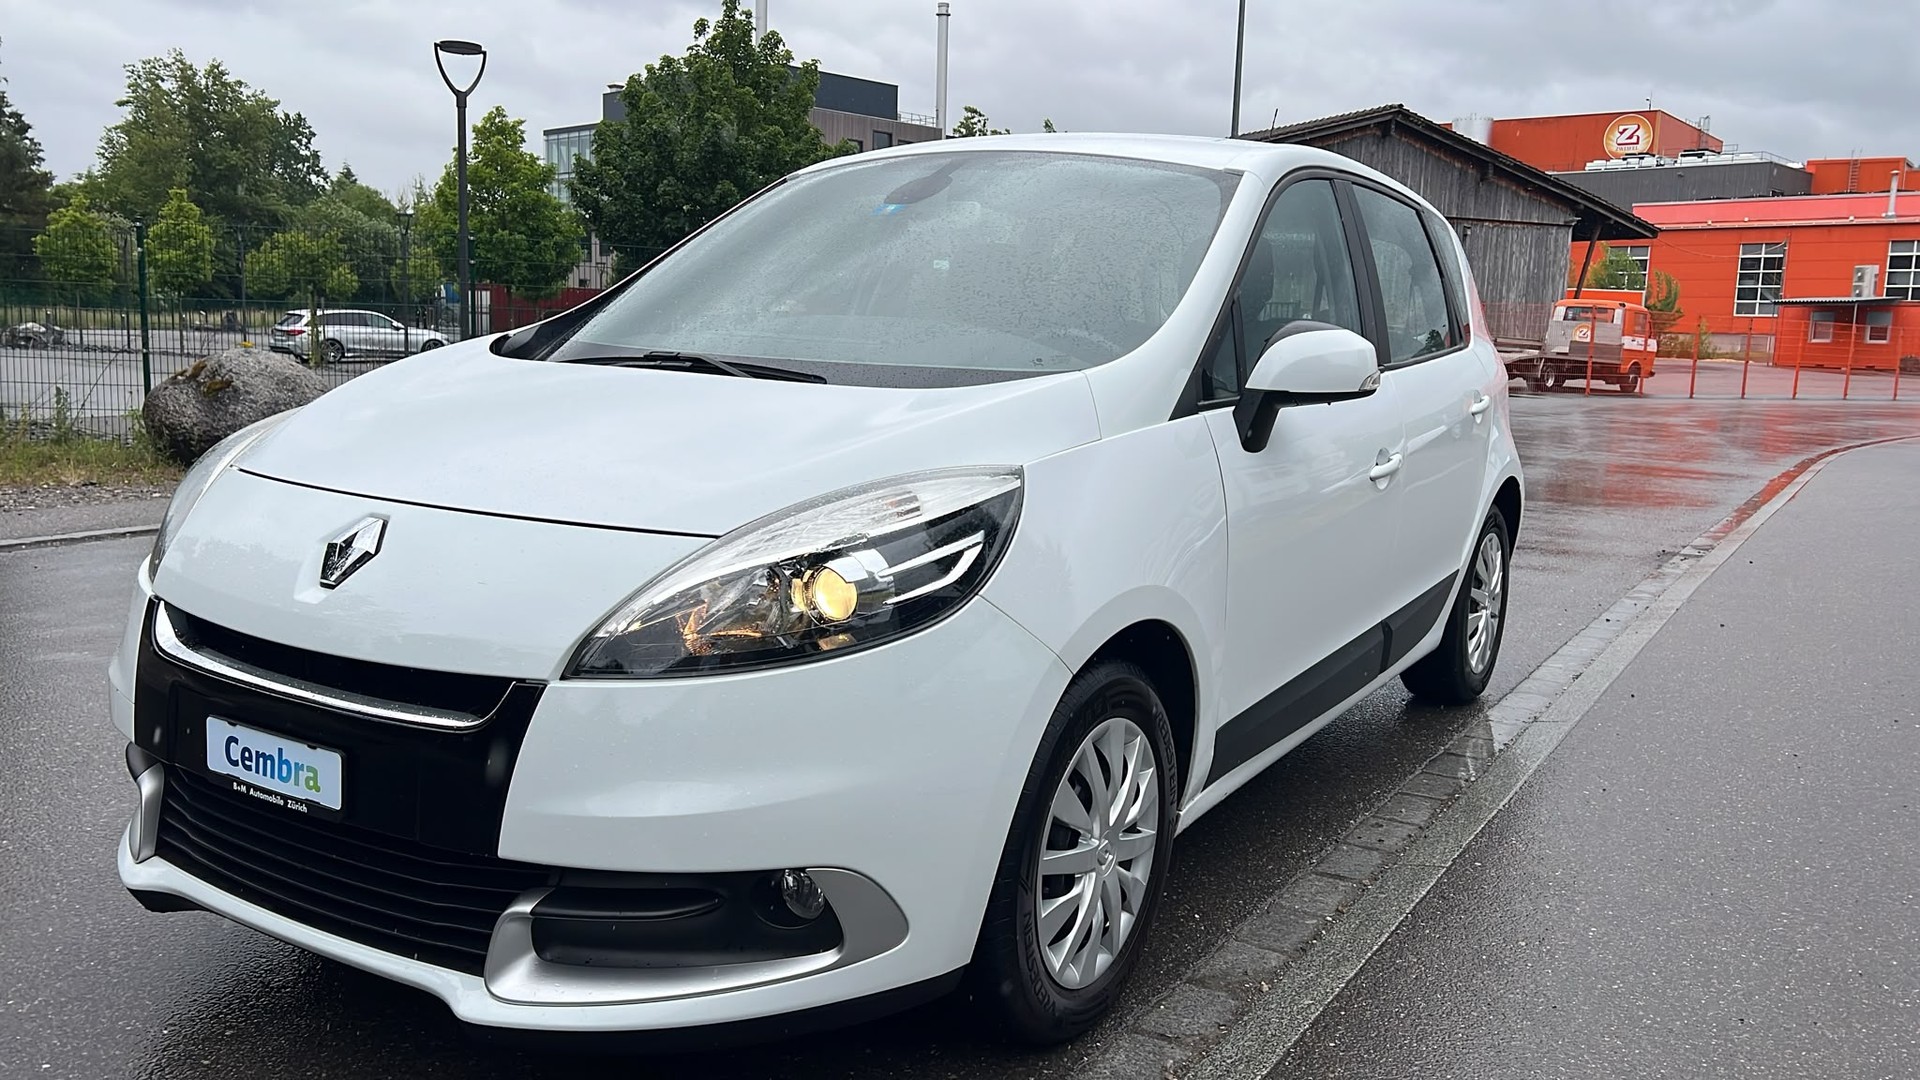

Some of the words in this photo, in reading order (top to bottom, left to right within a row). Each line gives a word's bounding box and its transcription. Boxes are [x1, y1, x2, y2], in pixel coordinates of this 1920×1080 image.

[1616, 123, 1640, 146] Z
[1578, 328, 1589, 338] Z
[224, 735, 321, 793] Cembra
[233, 781, 247, 794] B+M
[249, 788, 284, 806] Automobile
[287, 800, 308, 813] Zürich
[1023, 912, 1058, 1017] VREDESTEIN
